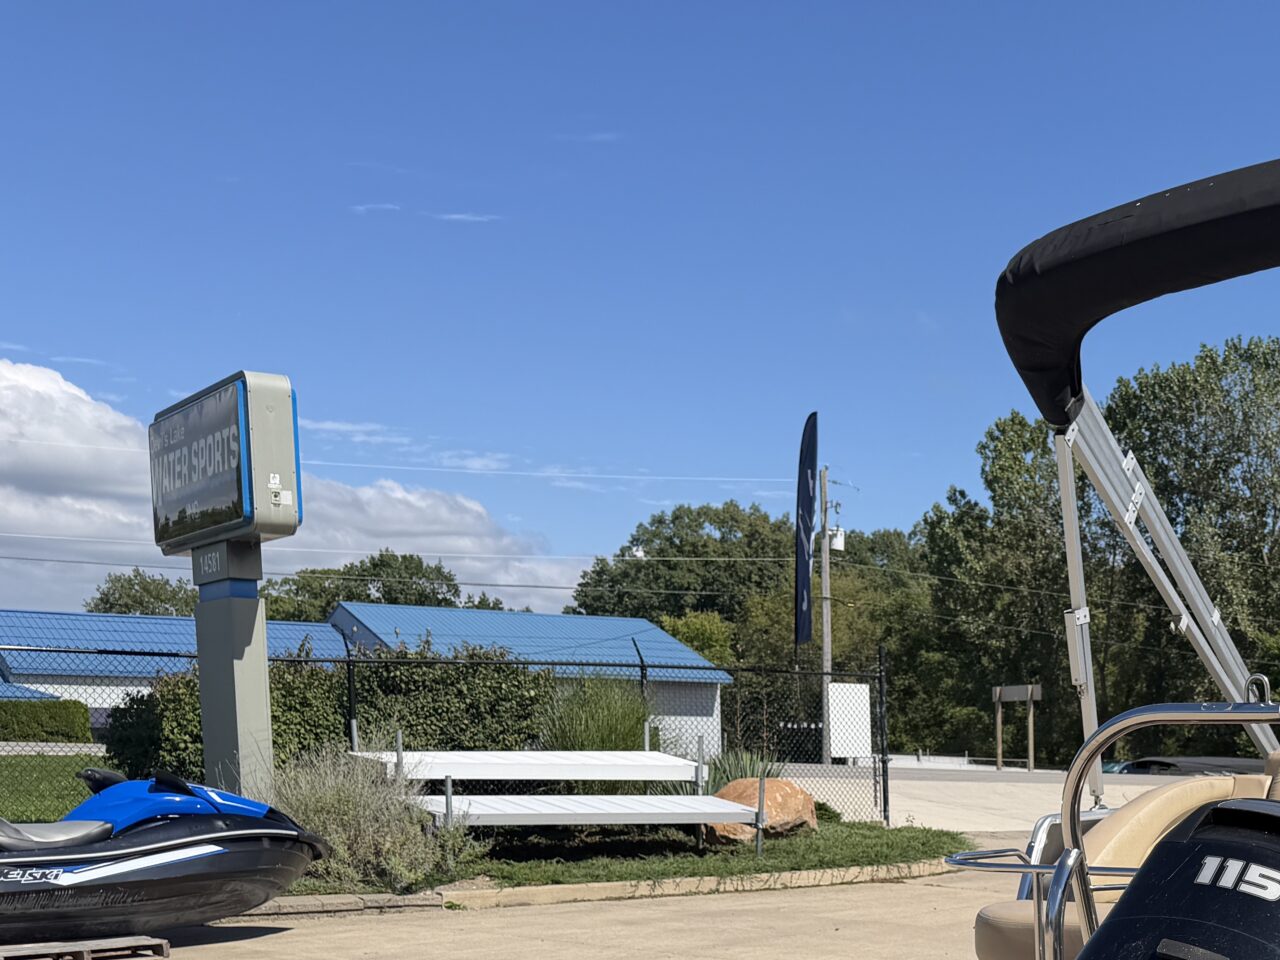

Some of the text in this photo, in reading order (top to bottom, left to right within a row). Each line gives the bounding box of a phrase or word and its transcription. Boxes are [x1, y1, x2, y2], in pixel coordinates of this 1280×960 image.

[151, 424, 239, 508] WATER SPORTS
[200, 552, 220, 575] 14581
